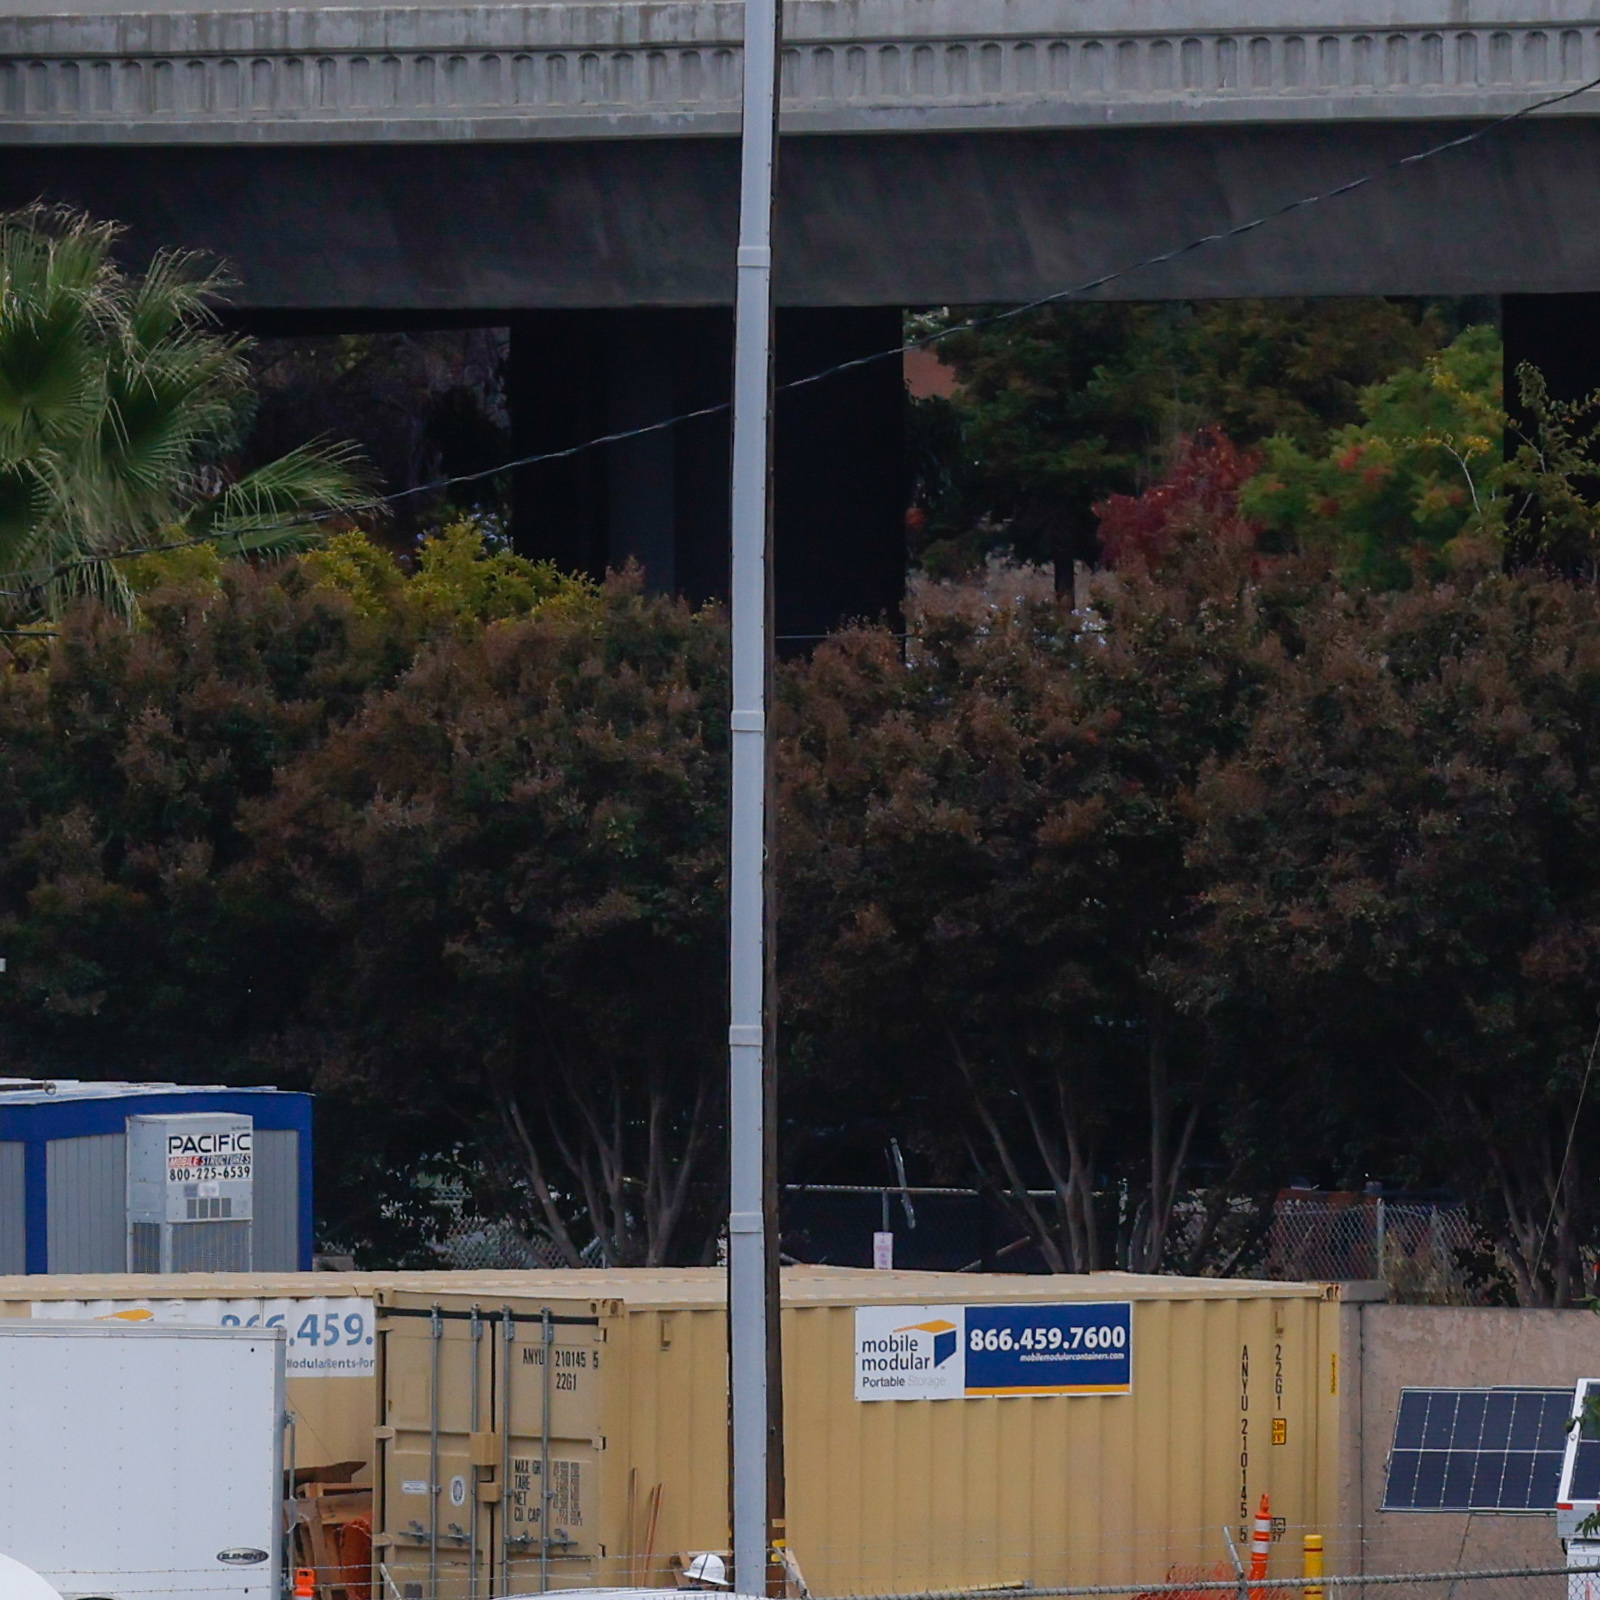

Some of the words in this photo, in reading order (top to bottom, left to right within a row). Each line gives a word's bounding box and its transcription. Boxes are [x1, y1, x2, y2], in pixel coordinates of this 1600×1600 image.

[169, 1166, 251, 1181] 800-225-6539
[861, 1334, 919, 1354] mobile
[969, 1325, 1126, 1351] 866.459.7600
[522, 1347, 544, 1366] ANYU
[555, 1350, 587, 1368] 210145
[861, 1352, 930, 1371] modular
[556, 1372, 578, 1391] 22G1
[862, 1376, 906, 1388] Portable
[908, 1375, 947, 1389] Storage
[1241, 1344, 1249, 1412] ANYU
[1275, 1343, 1283, 1411] 22G1
[1240, 1418, 1249, 1518] 210145
